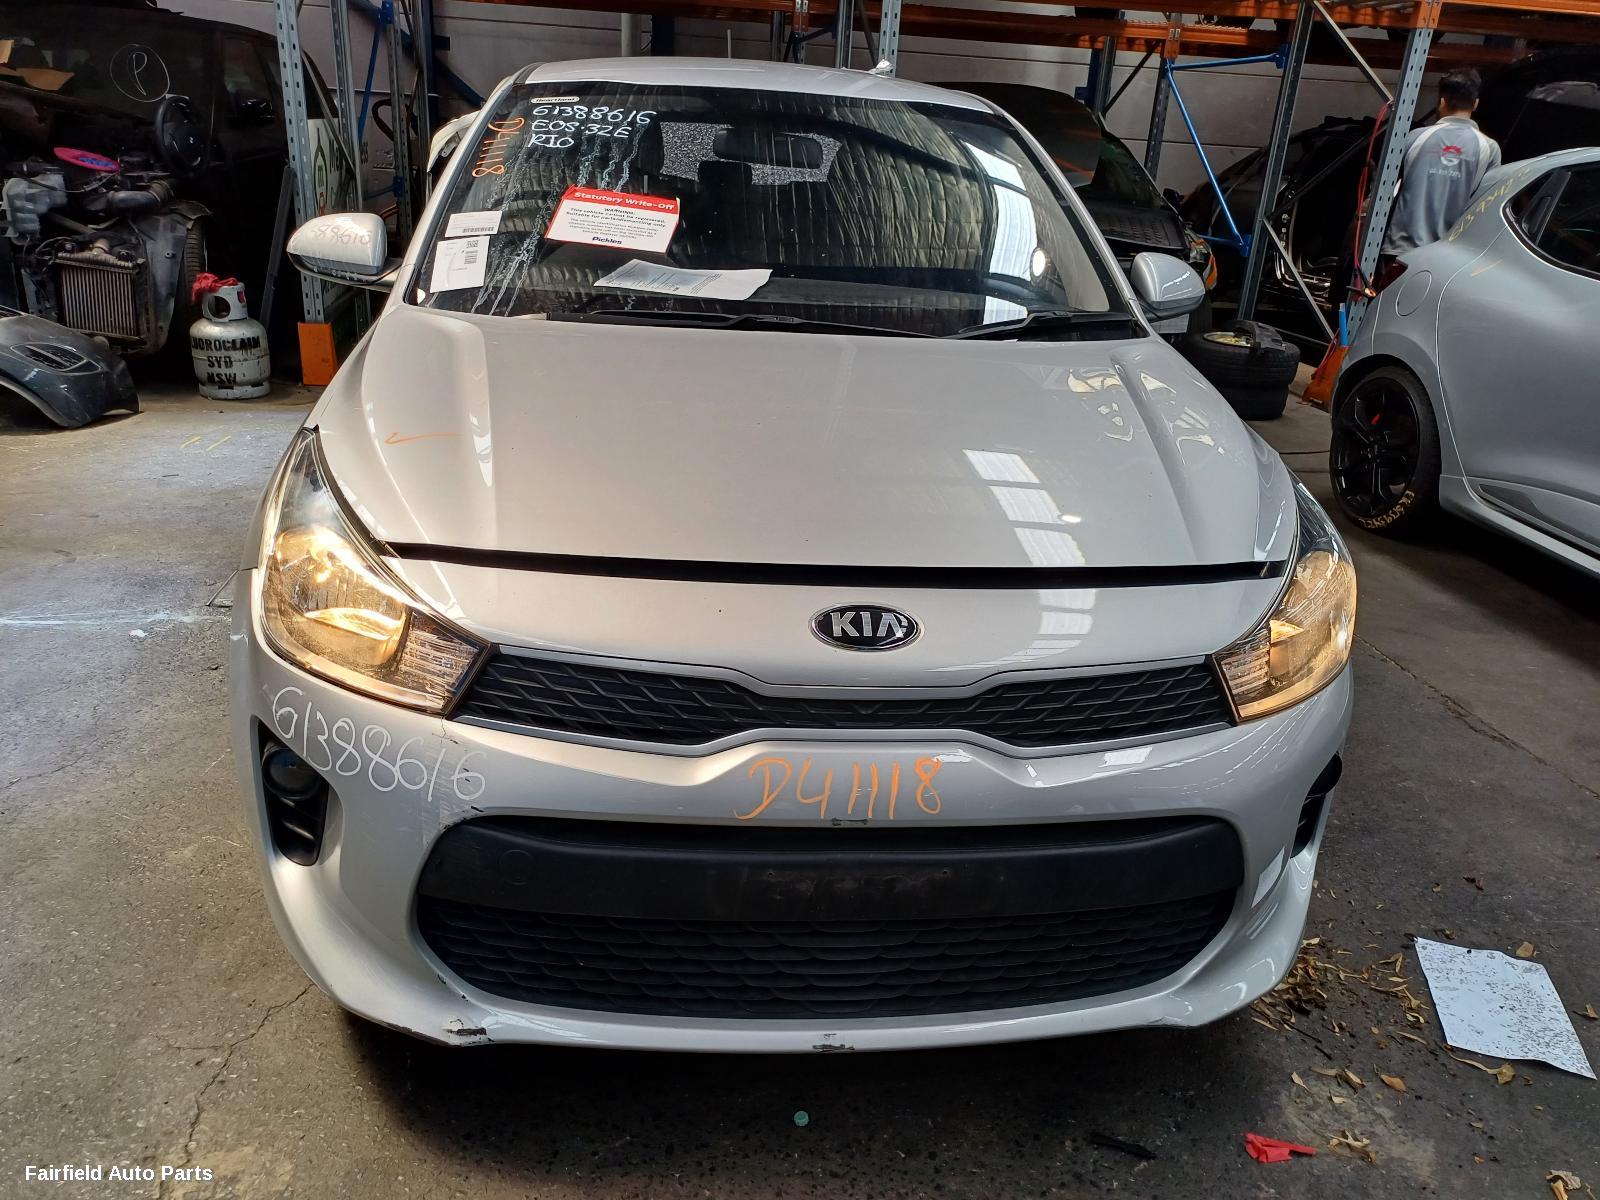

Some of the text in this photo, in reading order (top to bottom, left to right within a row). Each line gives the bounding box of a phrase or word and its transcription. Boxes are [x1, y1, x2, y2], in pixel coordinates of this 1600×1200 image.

[532, 105, 657, 124] 61388616
[527, 133, 575, 148] RIO
[573, 191, 675, 211] Statutory Write-Off
[591, 236, 622, 245] Pickles
[207, 356, 234, 369] SYD
[829, 611, 908, 639] KIA
[272, 687, 487, 802] 61388616
